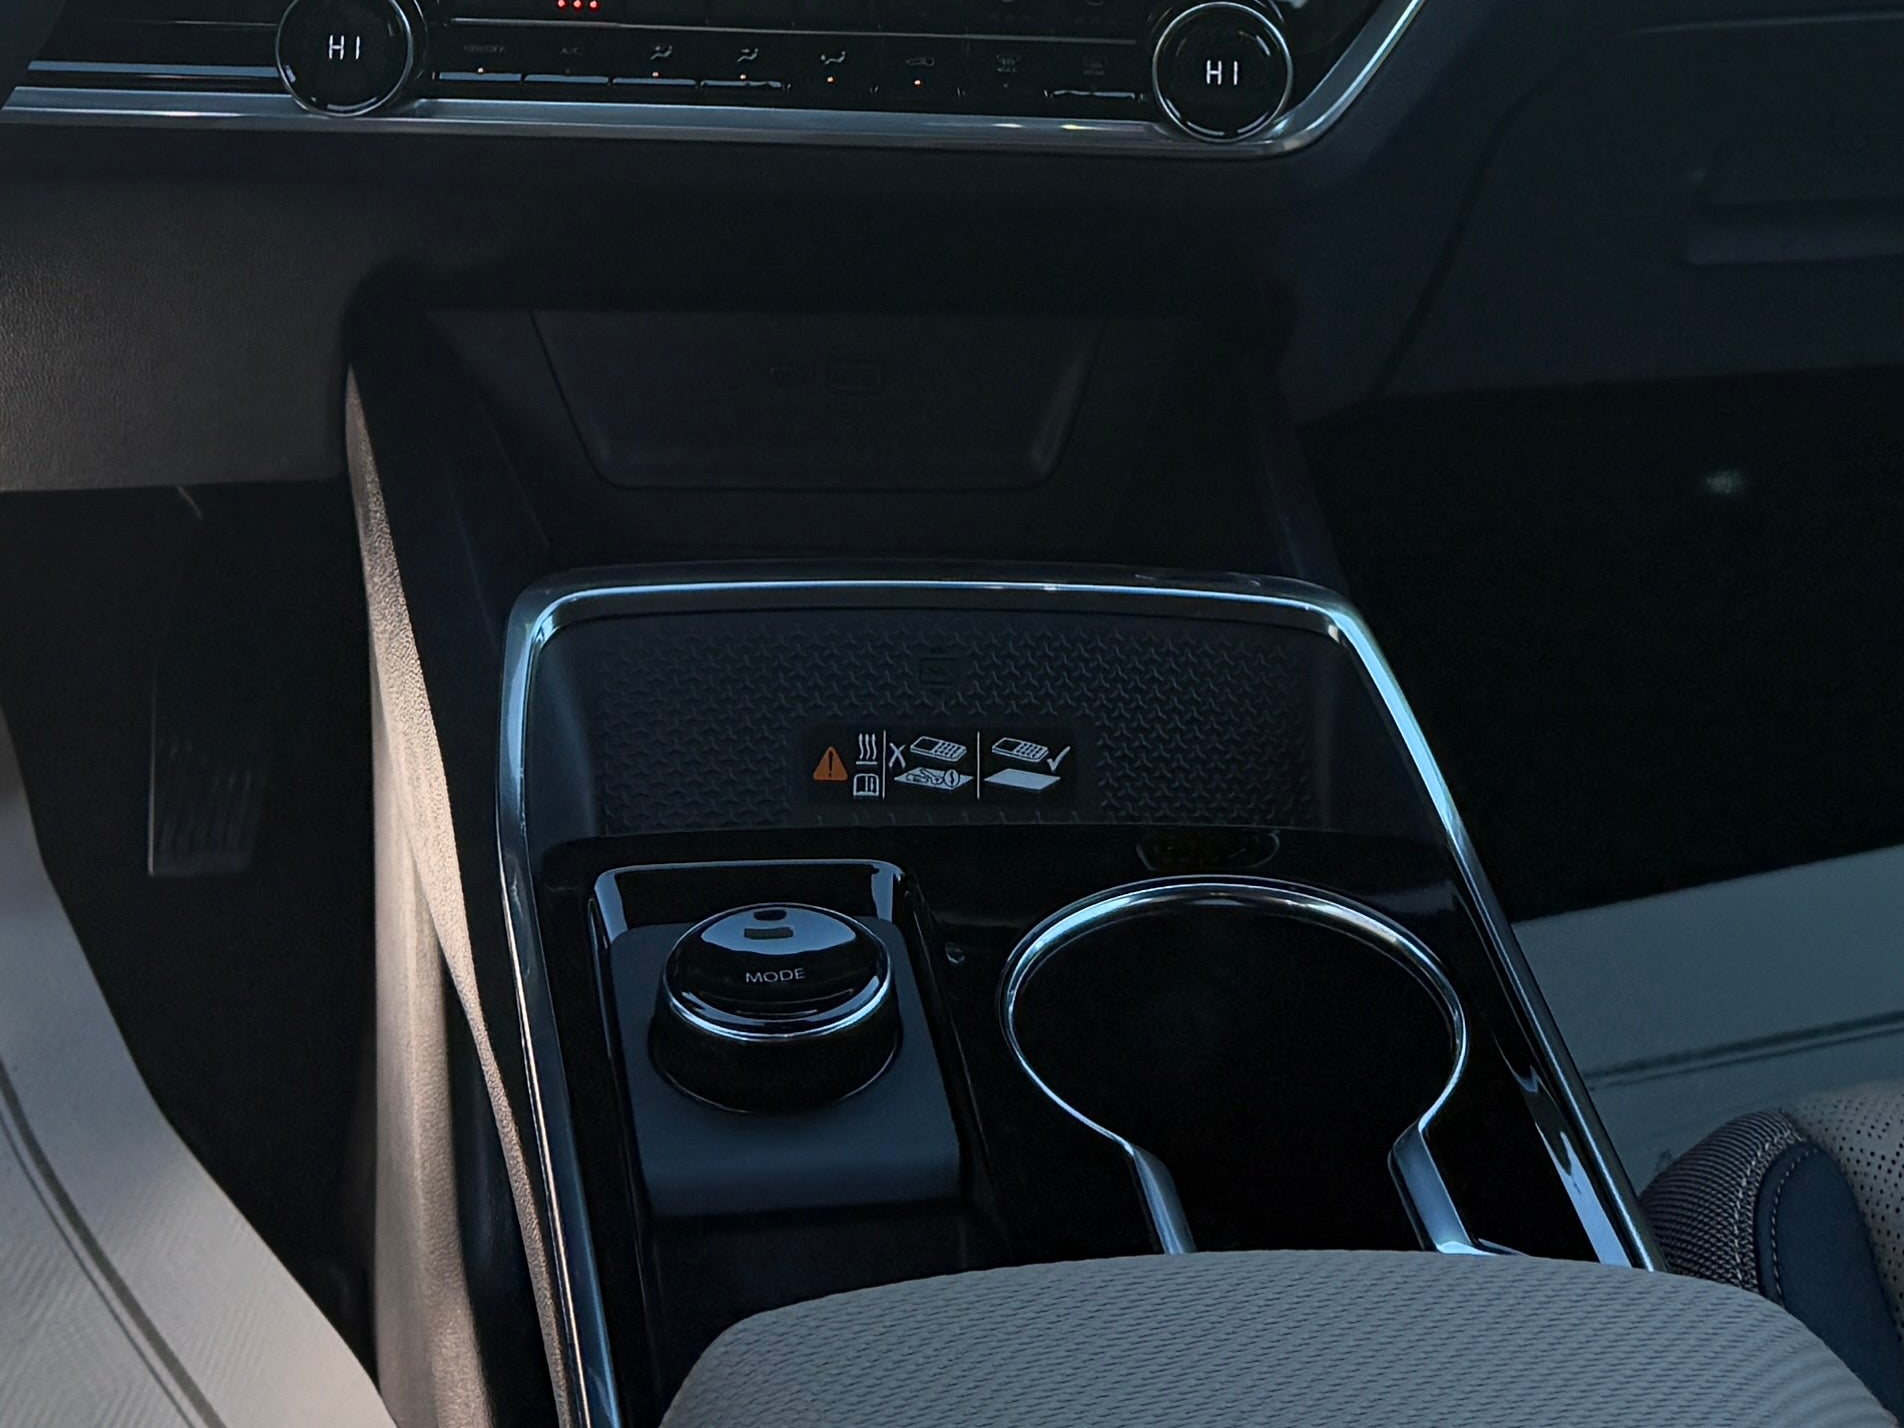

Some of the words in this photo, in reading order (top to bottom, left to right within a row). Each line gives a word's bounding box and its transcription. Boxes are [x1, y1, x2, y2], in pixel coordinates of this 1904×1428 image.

[327, 32, 363, 62] HI
[1206, 59, 1239, 88] HI
[744, 965, 806, 984] MODE
